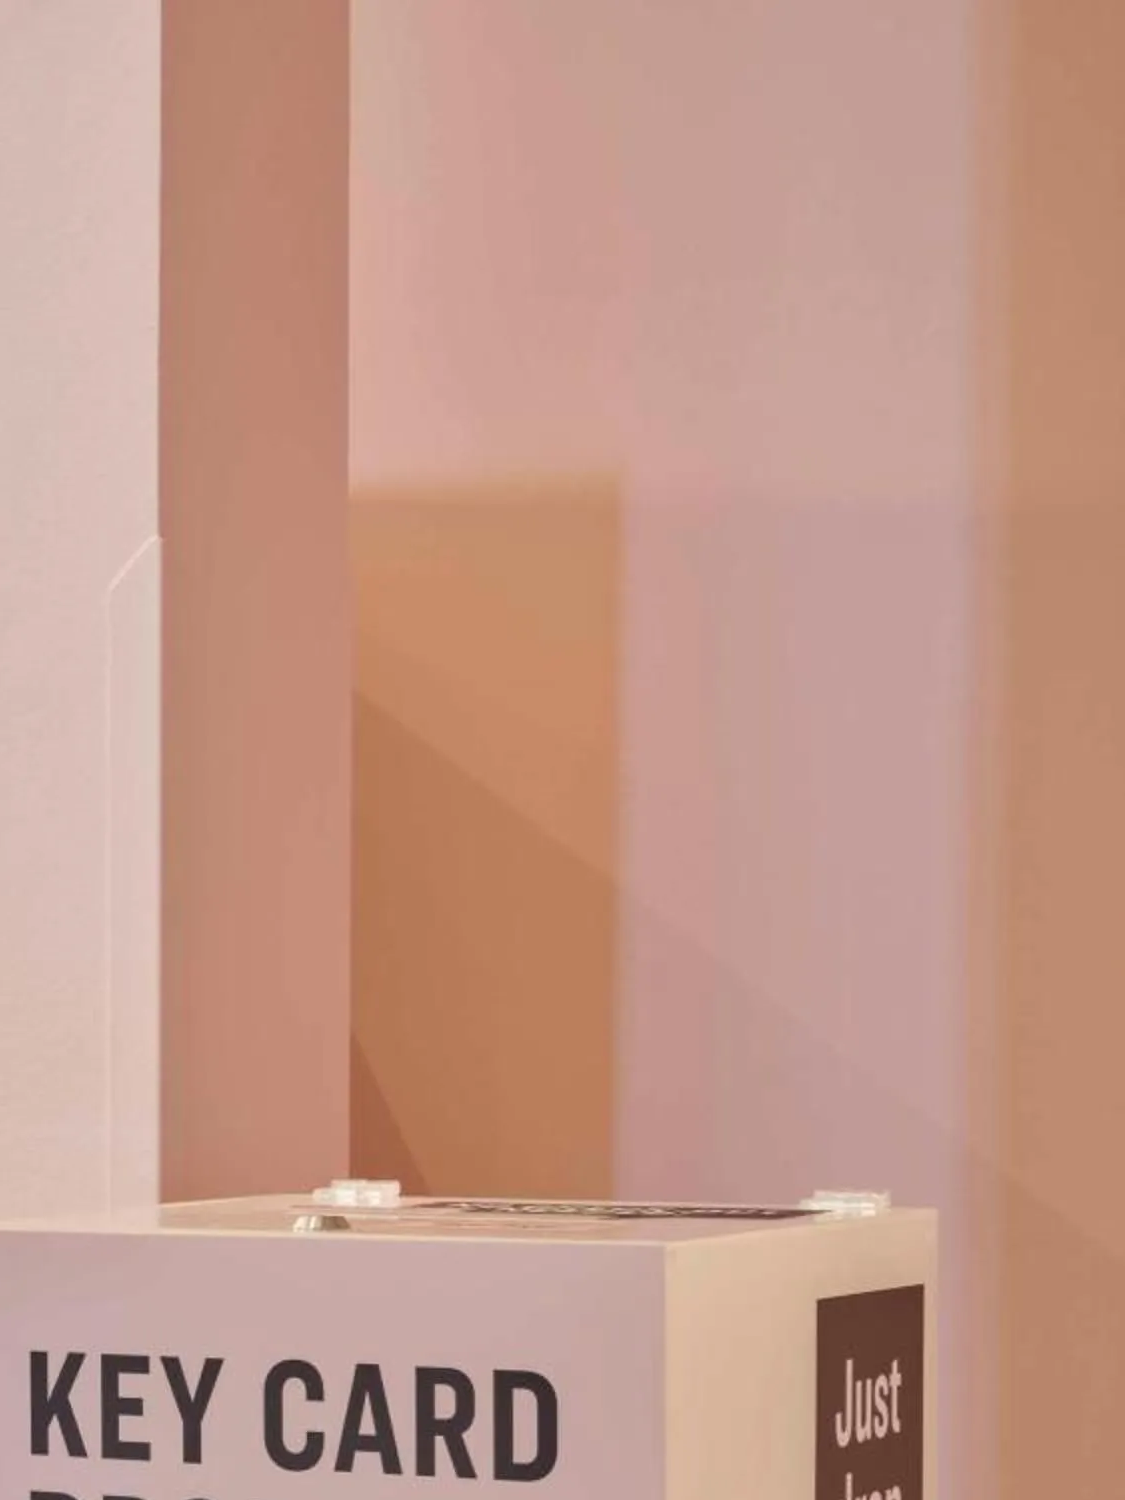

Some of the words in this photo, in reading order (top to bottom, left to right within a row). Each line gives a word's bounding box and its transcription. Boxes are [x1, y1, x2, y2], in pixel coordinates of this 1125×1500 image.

[29, 1349, 225, 1465] KEY
[263, 1358, 559, 1484] CARD
[835, 1358, 902, 1448] Just
